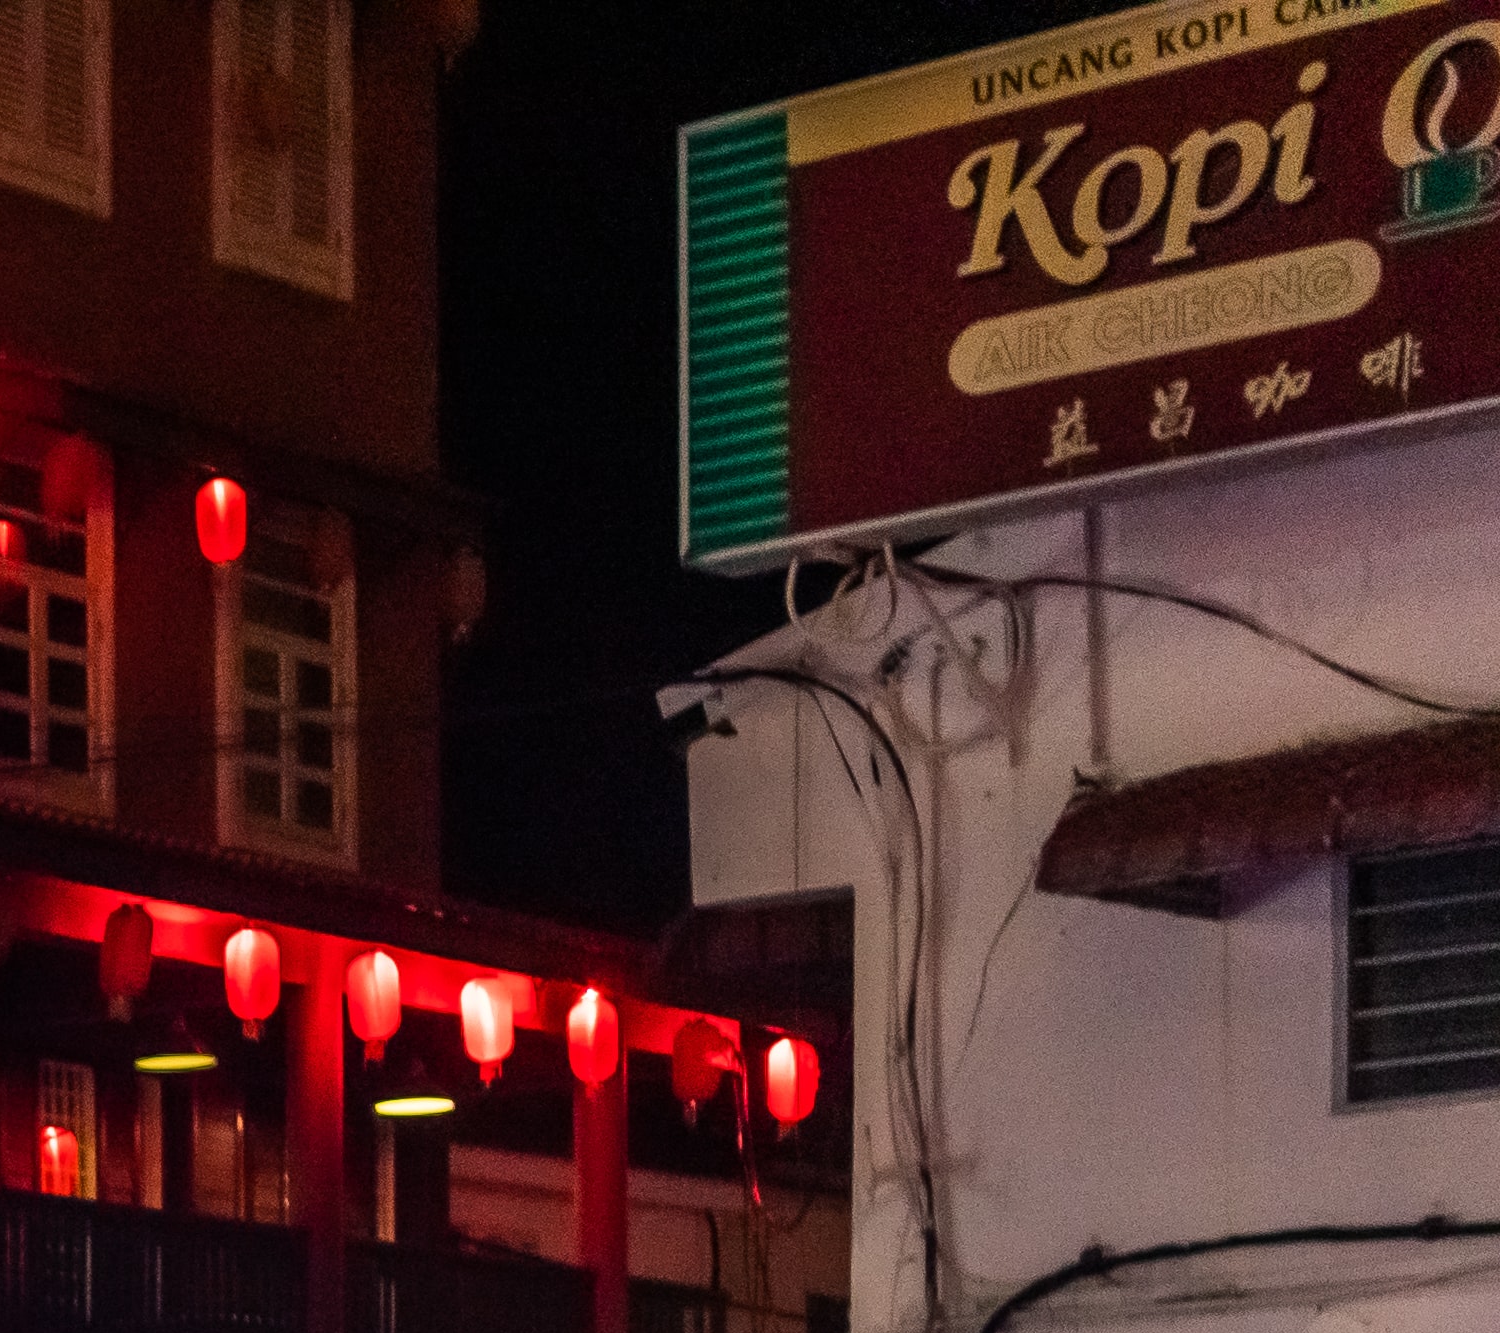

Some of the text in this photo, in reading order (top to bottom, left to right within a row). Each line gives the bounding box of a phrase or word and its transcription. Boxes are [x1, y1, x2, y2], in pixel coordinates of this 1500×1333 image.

[971, 36, 1134, 105] UNCANG
[1154, 5, 1251, 58] KOPI
[946, 59, 1329, 287] Kopi
[973, 316, 1073, 384] AIK
